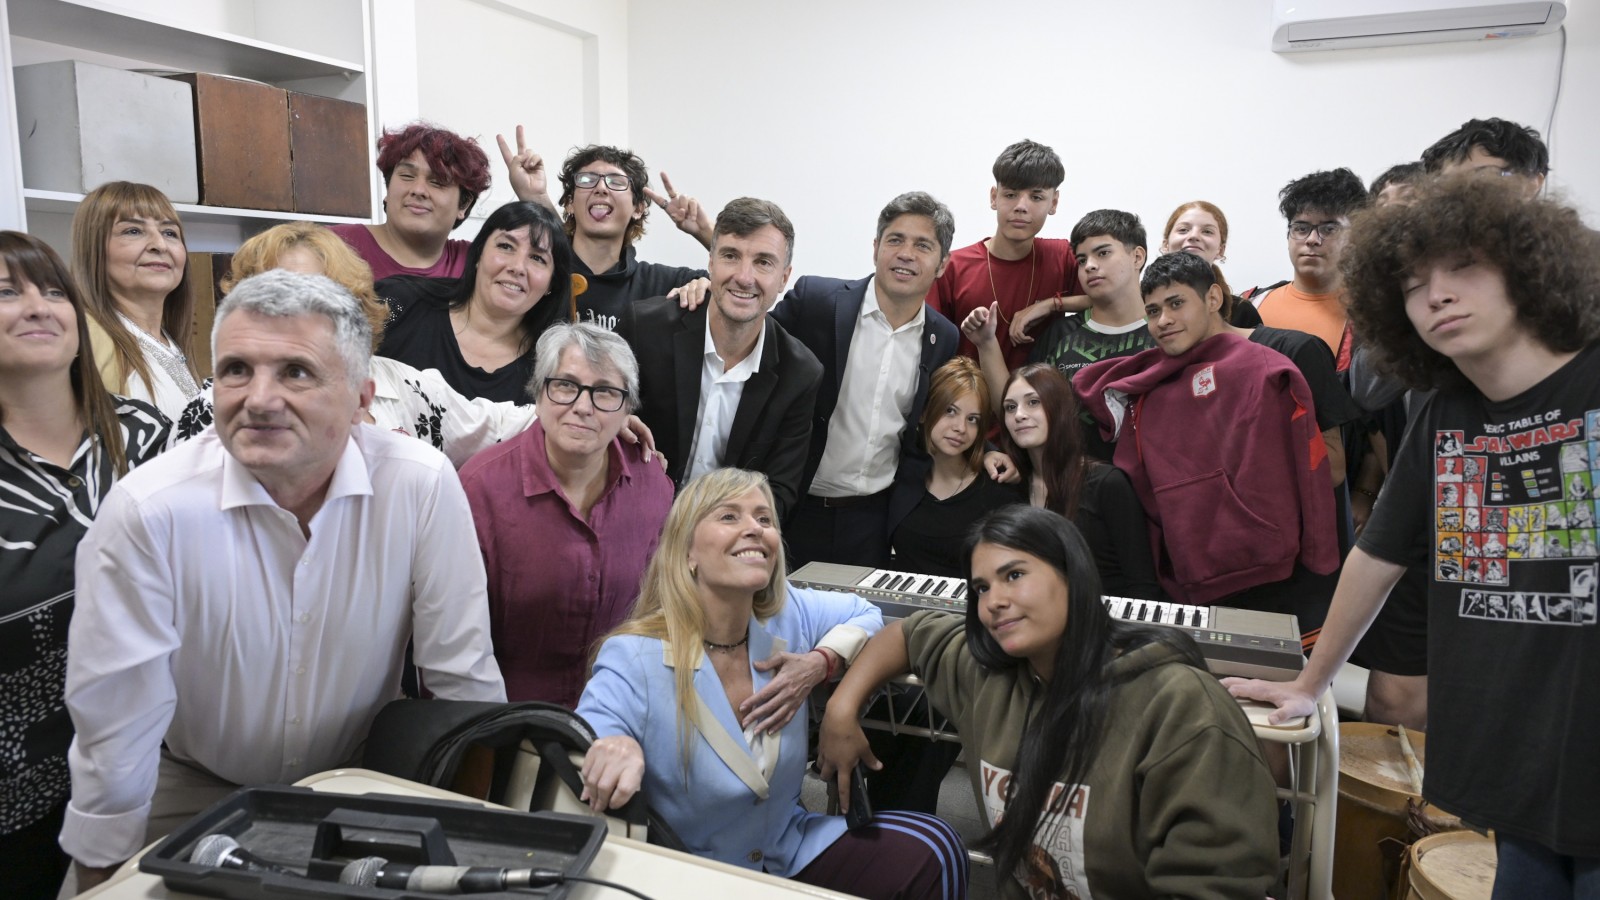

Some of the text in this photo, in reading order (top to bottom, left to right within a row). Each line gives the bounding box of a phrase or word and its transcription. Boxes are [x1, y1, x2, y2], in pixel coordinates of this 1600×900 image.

[1508, 414, 1543, 431] TABLE
[1544, 409, 1561, 422] OF
[1507, 418, 1584, 451] WARS
